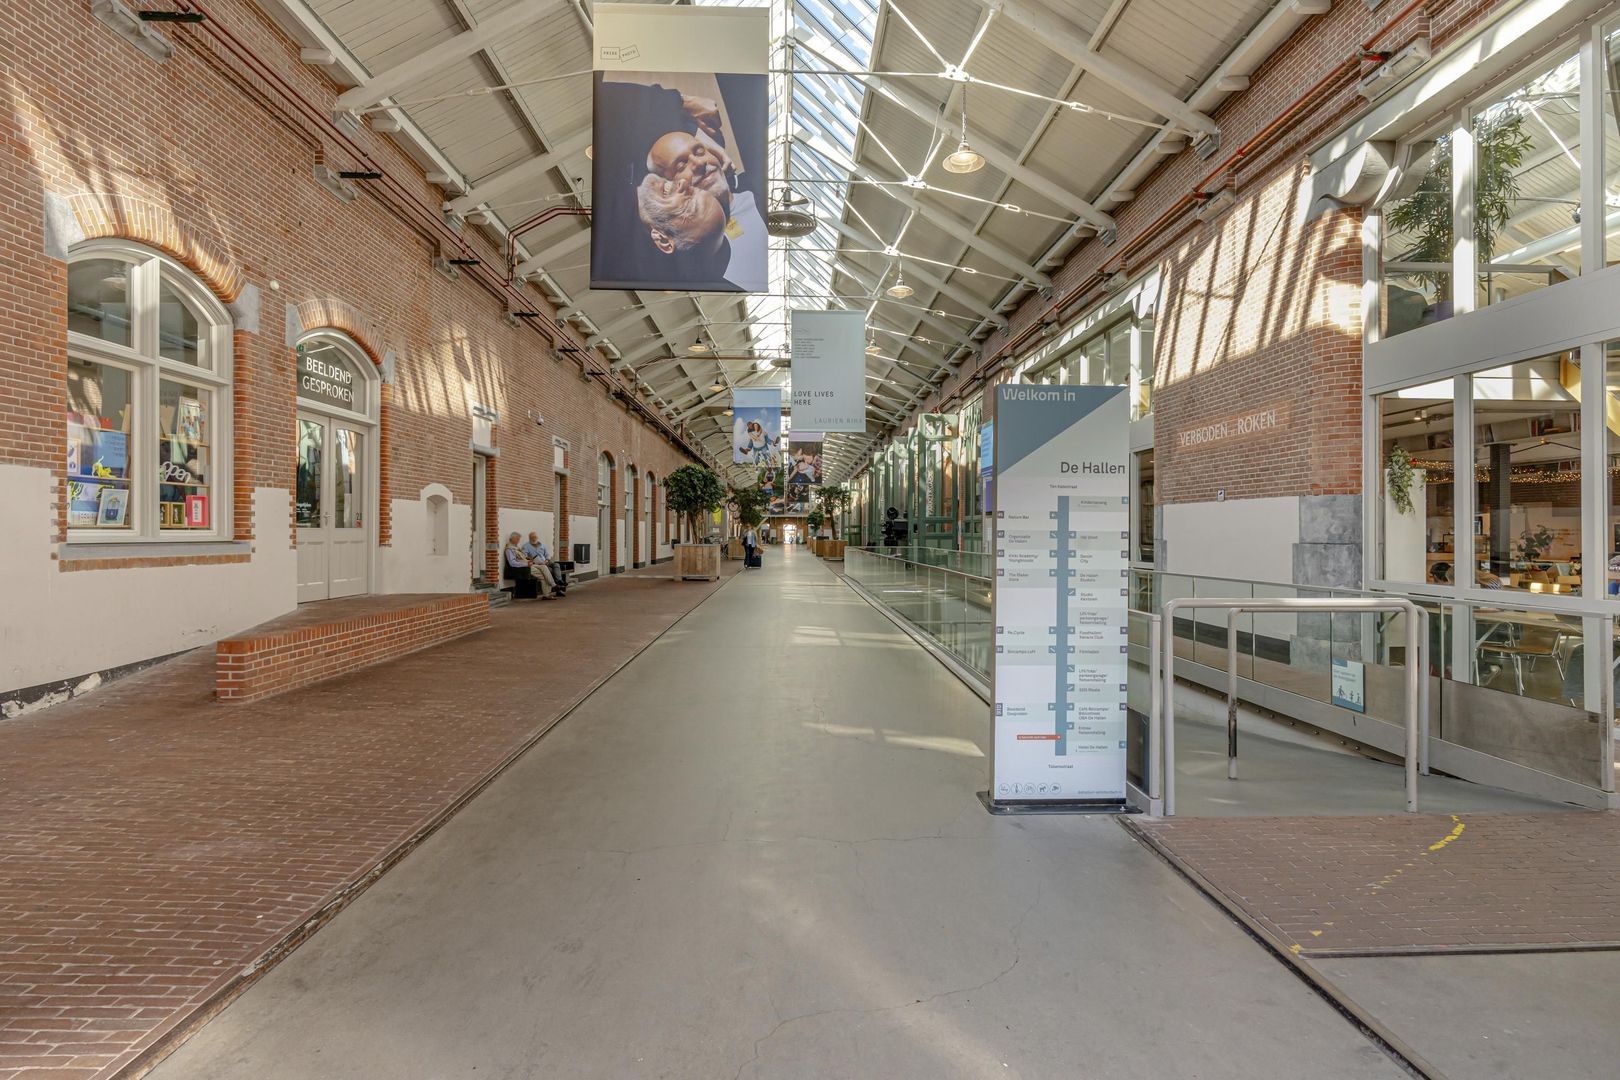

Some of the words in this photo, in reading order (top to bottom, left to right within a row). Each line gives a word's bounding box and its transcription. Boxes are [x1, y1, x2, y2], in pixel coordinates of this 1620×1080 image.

[306, 357, 352, 384] BEELDEND
[302, 376, 354, 402] GESPROKEN
[1002, 388, 1060, 401] Welkom
[1064, 389, 1076, 402] in
[1180, 422, 1228, 446] VERBODEN
[1238, 410, 1276, 434] ROKEN
[1060, 462, 1078, 474] De
[1082, 462, 1126, 474] Hallen
